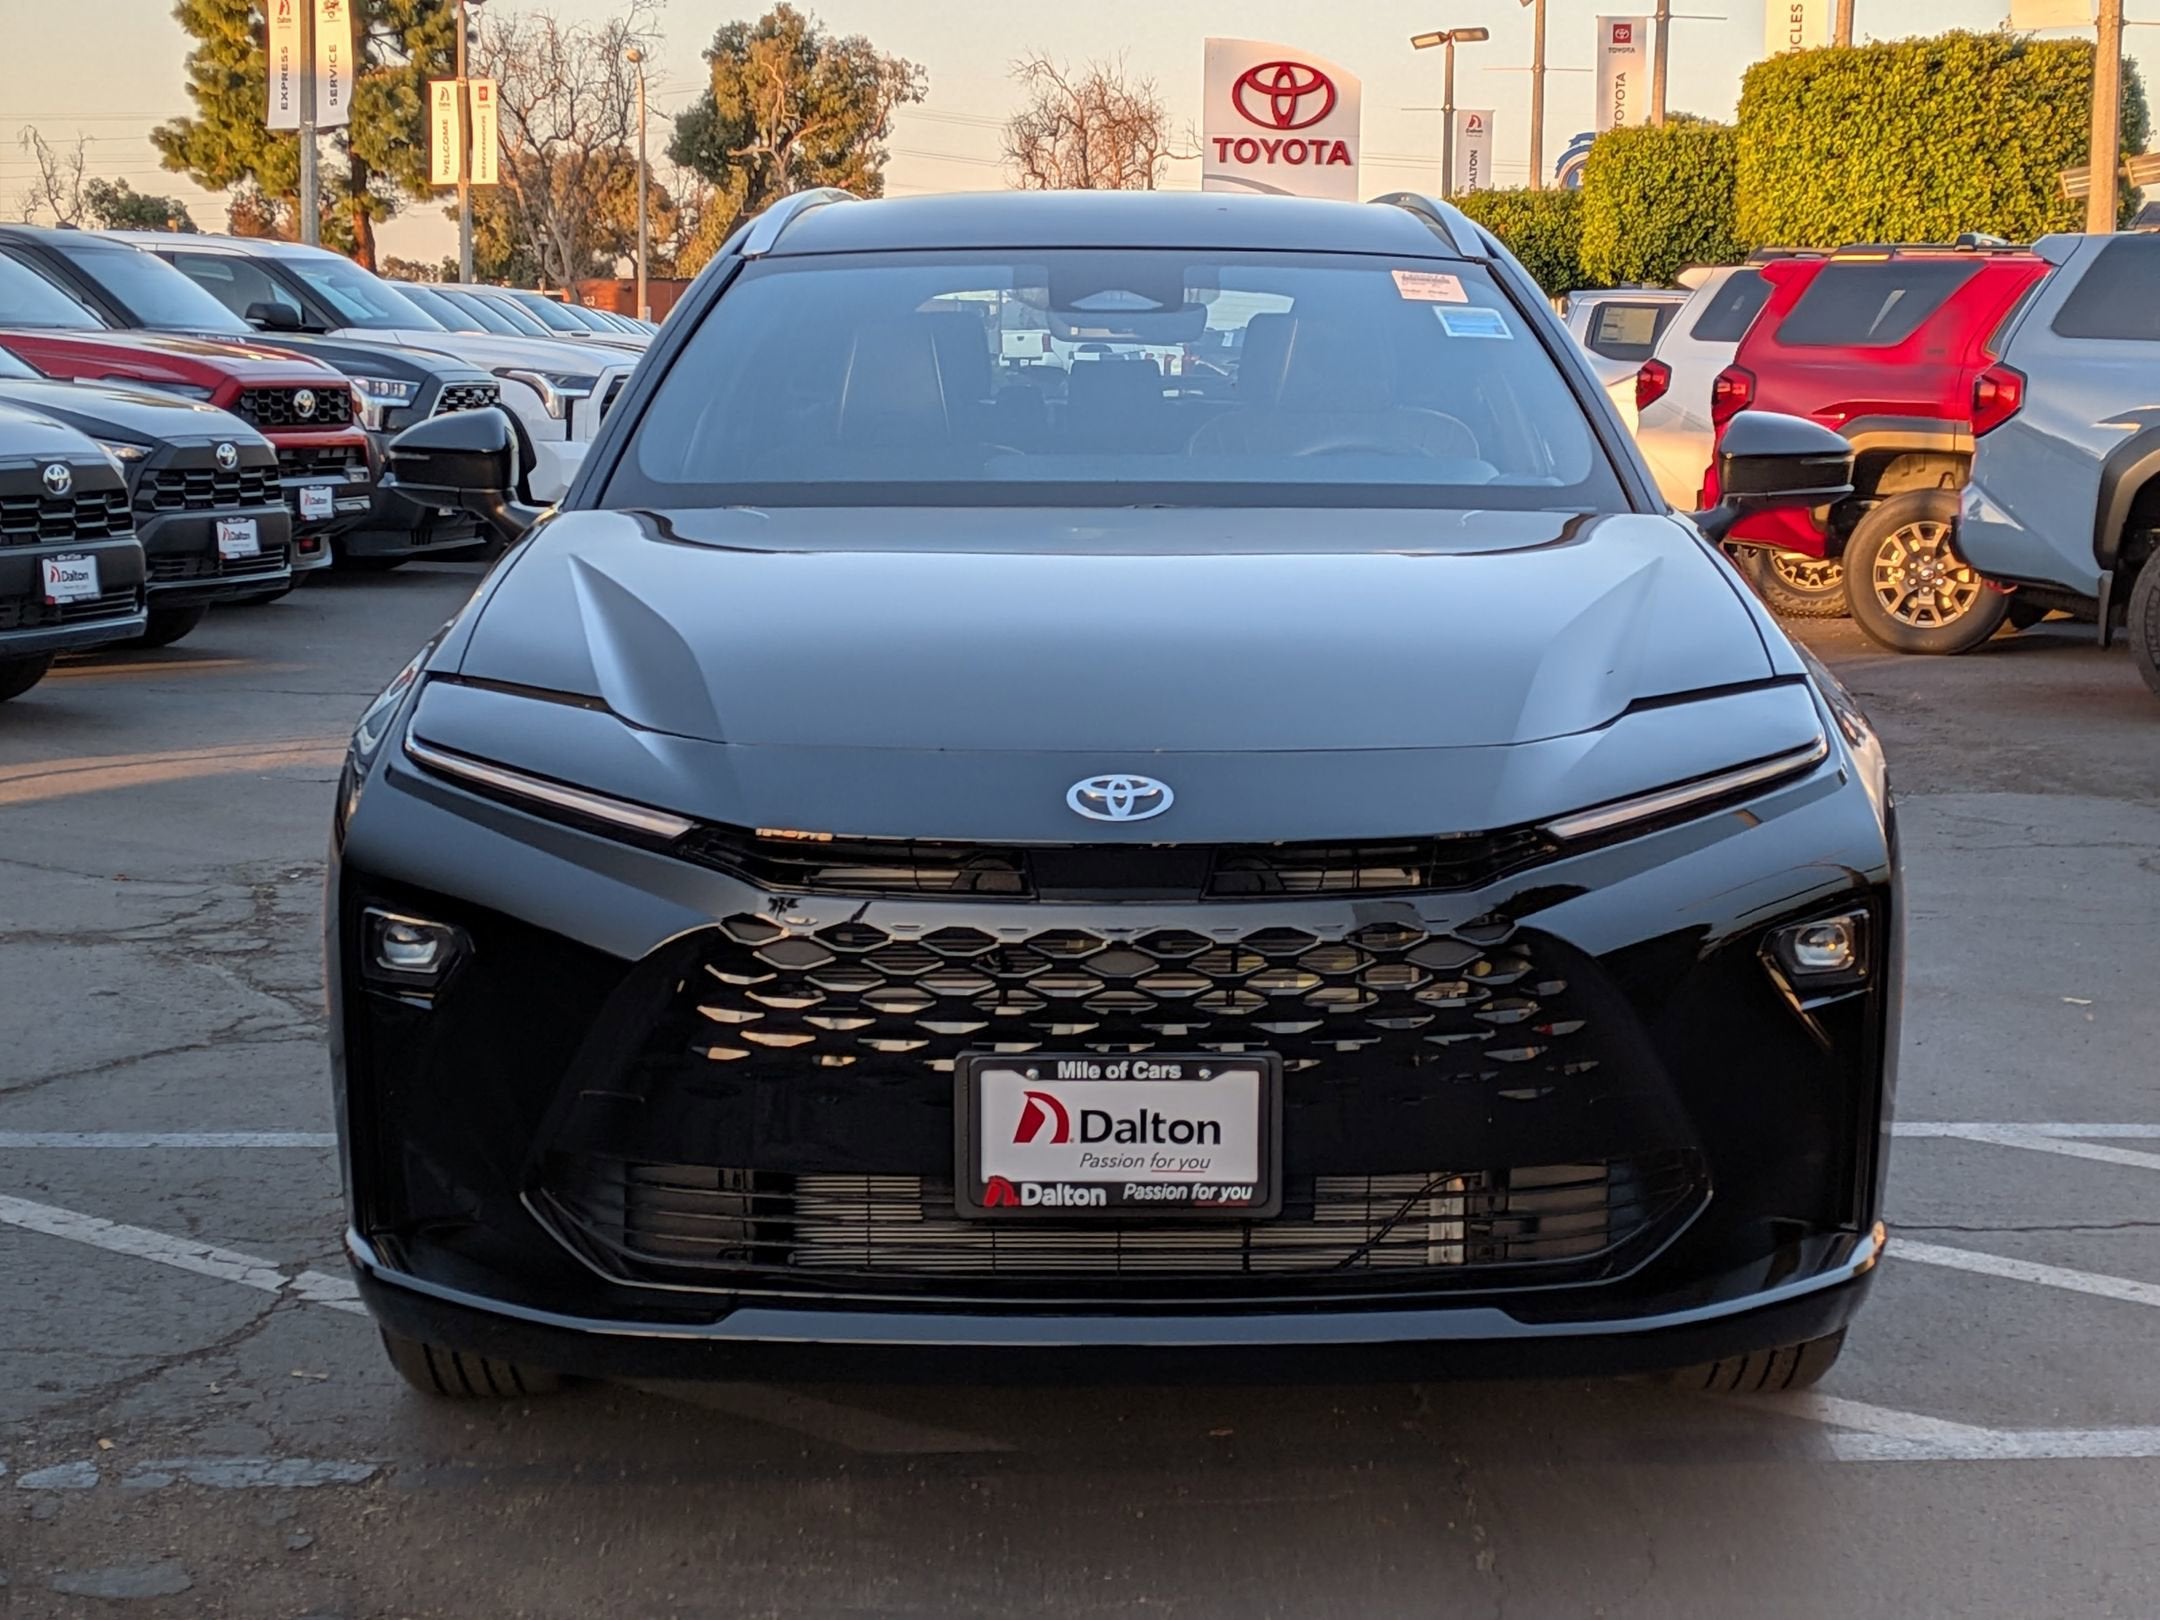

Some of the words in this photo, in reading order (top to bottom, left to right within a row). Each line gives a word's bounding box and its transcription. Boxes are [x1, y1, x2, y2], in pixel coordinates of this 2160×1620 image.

[1608, 46, 1635, 54] TOYOTA
[280, 46, 288, 110] EXPRESS
[329, 44, 338, 106] SERVICE
[1614, 72, 1626, 128] TOYOTA
[442, 119, 450, 175] WELCOME
[1212, 137, 1352, 166] TOYOTA
[62, 570, 89, 582] Dalton
[1057, 1061, 1101, 1080] Mile
[1106, 1061, 1129, 1080] of
[1132, 1061, 1182, 1080] Cars
[1080, 1109, 1221, 1145] Dalton
[1079, 1153, 1145, 1169] Passion
[1150, 1152, 1175, 1169] for
[1178, 1156, 1211, 1173] you
[1020, 1183, 1107, 1206] Dalton
[1122, 1183, 1189, 1201] Passion
[1191, 1182, 1216, 1201] for
[1218, 1185, 1253, 1204] you
